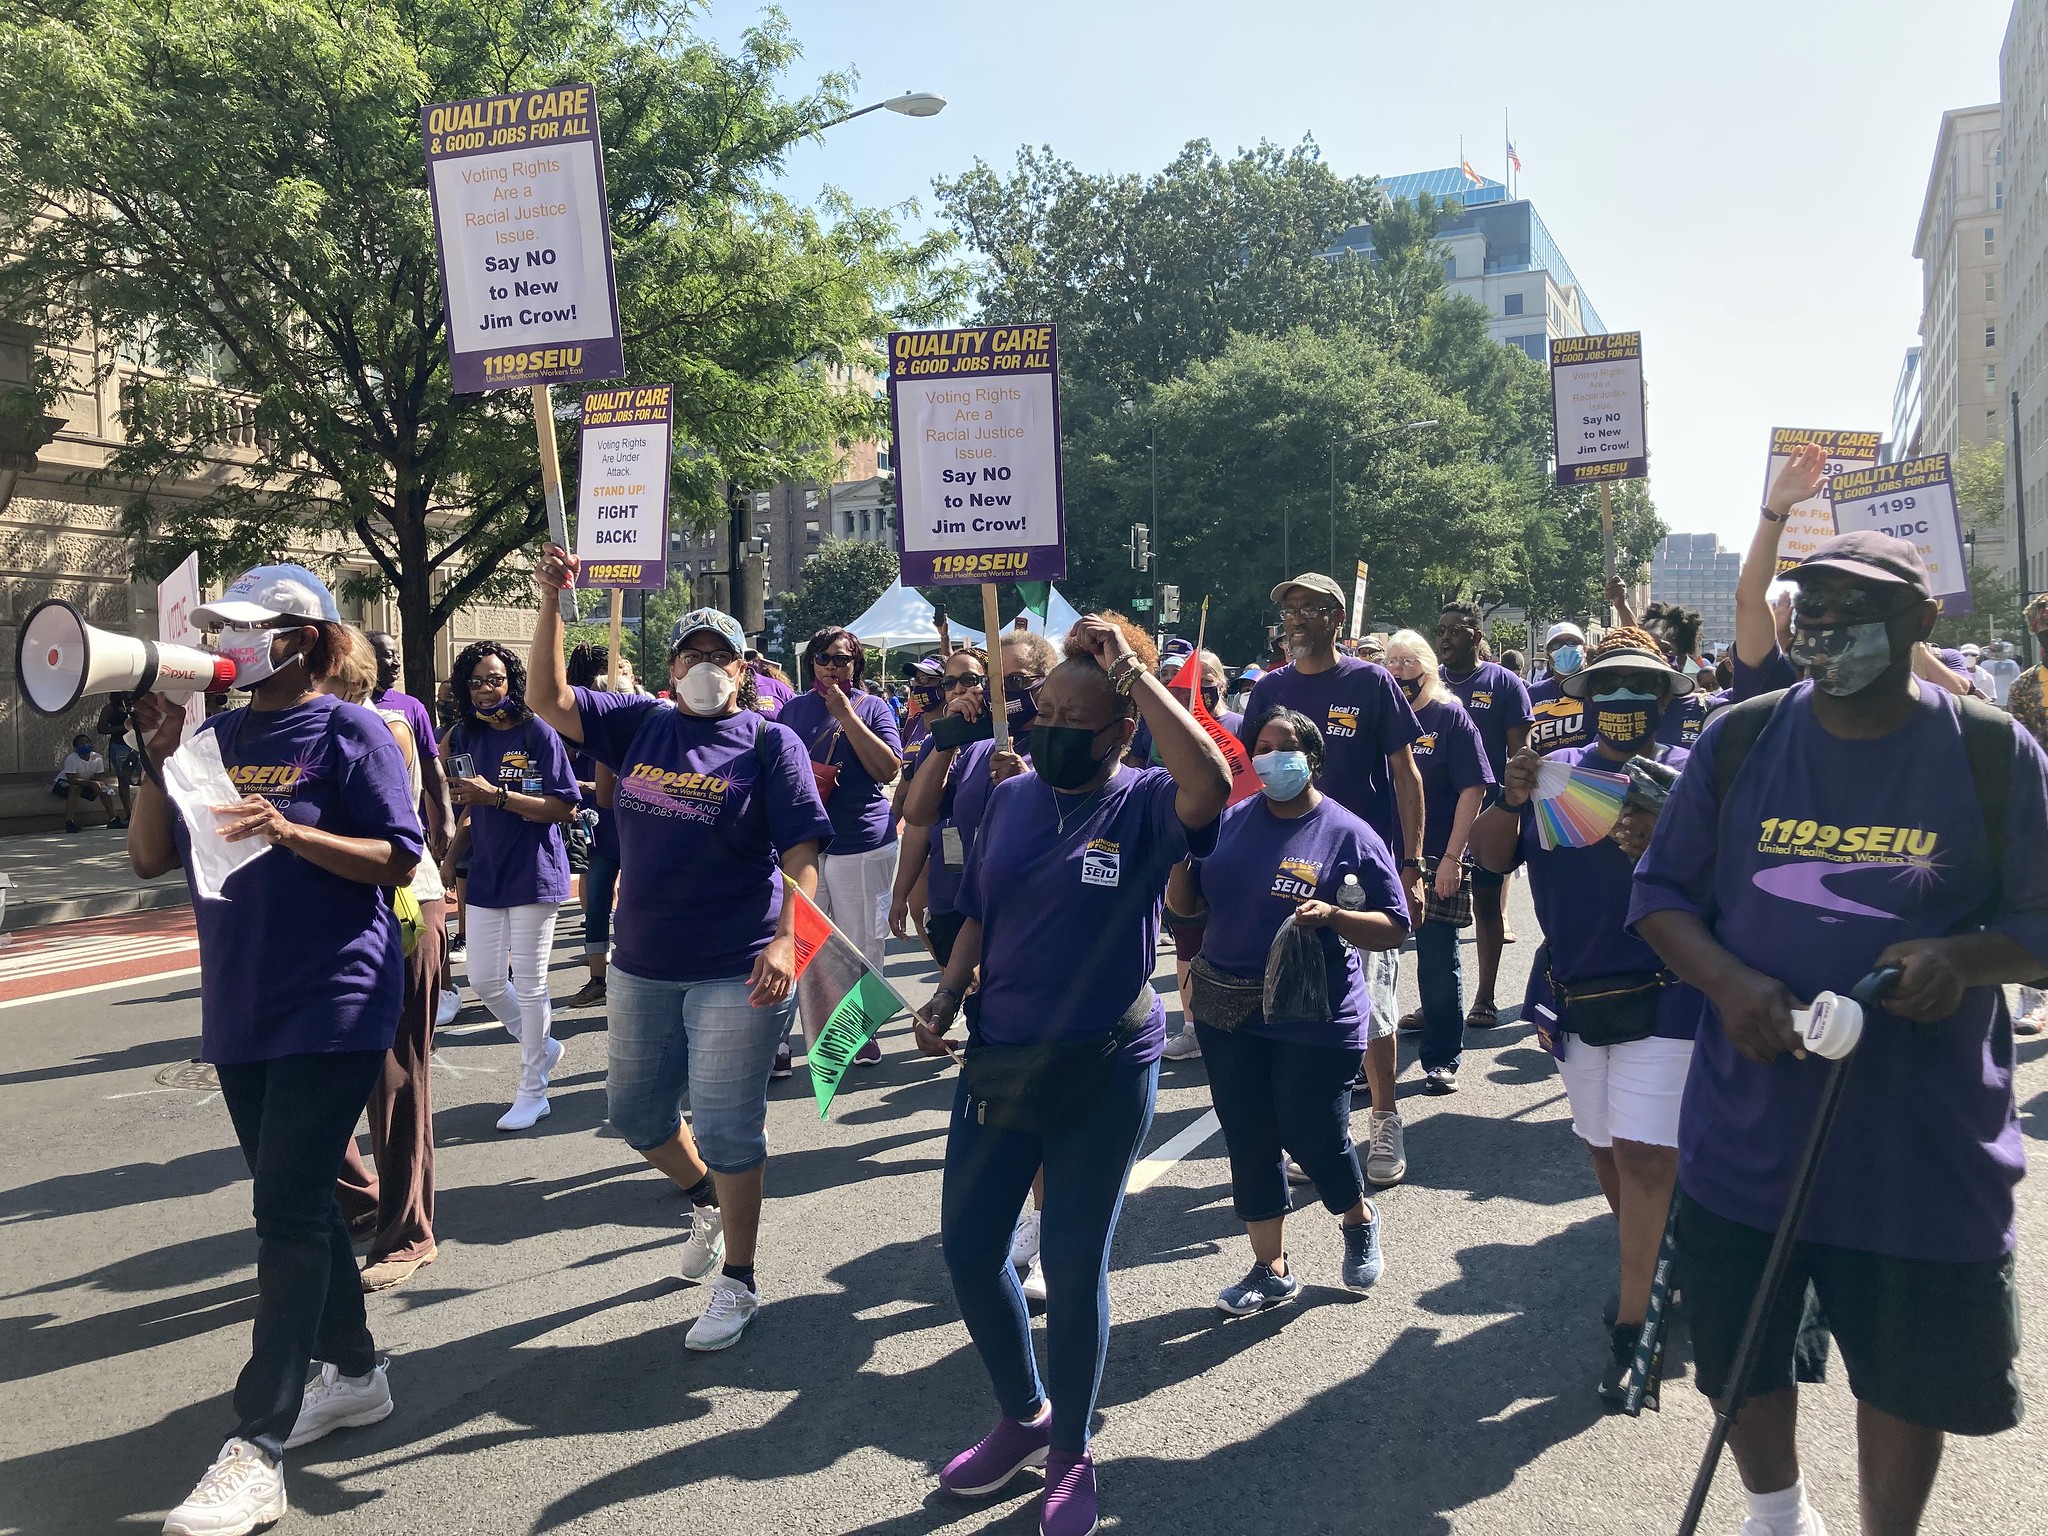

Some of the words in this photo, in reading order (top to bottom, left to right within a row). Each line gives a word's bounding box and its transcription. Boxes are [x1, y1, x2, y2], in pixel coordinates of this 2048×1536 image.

[429, 98, 522, 135] QUALITY
[528, 88, 588, 121] CARE
[431, 141, 442, 155] &
[446, 132, 485, 152] GOOD
[488, 127, 526, 146] JOBS
[529, 122, 559, 141] FOR
[562, 119, 590, 135] ALL
[461, 164, 508, 185] Voting
[512, 158, 560, 179] Rights
[493, 187, 518, 202] Are
[523, 186, 532, 198] a
[465, 209, 510, 228] Racial
[514, 202, 567, 221] Justice
[495, 229, 540, 245] Issue.
[485, 255, 520, 275] Say
[526, 249, 557, 267] NO
[489, 285, 508, 301] to
[514, 279, 559, 298] New
[479, 313, 513, 331] Jim
[519, 304, 578, 326] Crow!
[895, 331, 988, 359] QUALITY
[992, 328, 1051, 353] CARE
[1553, 336, 1603, 355] QUALITY
[1606, 333, 1639, 349] CARE
[483, 347, 582, 376] 1199SEIU
[895, 361, 907, 375] &
[911, 358, 949, 375] GOOD
[952, 356, 990, 373] JOBS
[993, 354, 1021, 370] FOR
[1024, 353, 1050, 369] ALL
[1553, 354, 1560, 364] &
[1562, 353, 1584, 363] GOOD
[1585, 350, 1606, 361] JOBS
[1607, 348, 1623, 359] FOR
[1624, 347, 1639, 357] ALL
[486, 374, 506, 383] United
[506, 370, 539, 381] Healthcare
[540, 367, 569, 378] Workers
[570, 366, 584, 375] East
[1572, 370, 1598, 381] Voting
[584, 390, 635, 413] QUALITY
[635, 387, 670, 408] CARE
[926, 390, 971, 405] Voting
[976, 387, 1021, 404] Rights
[584, 414, 590, 425] &
[591, 411, 612, 424] GOOD
[612, 409, 634, 422] JOBS
[634, 408, 651, 421] FOR
[651, 407, 668, 419] ALL
[955, 410, 980, 422] Are
[985, 411, 993, 420] a
[1582, 415, 1602, 426] Say
[1605, 412, 1621, 422] NO
[926, 428, 970, 443] Racial
[974, 426, 1024, 440] Justice
[1584, 431, 1595, 440] to
[1598, 428, 1622, 438] New
[1774, 428, 1836, 446] QUALITY
[1837, 432, 1880, 447] CARE
[597, 439, 621, 452] Voting
[621, 437, 647, 450] Rights
[1577, 445, 1597, 455] Jim
[1599, 440, 1630, 452] Crow!
[1772, 443, 1780, 452] &
[1836, 447, 1856, 456] FOR
[1857, 448, 1876, 458] ALL
[602, 453, 615, 464] Are
[616, 451, 640, 463] Under
[955, 447, 997, 460] Issue.
[606, 466, 632, 478] Attack.
[942, 468, 977, 486] Say
[983, 466, 1012, 482] NO
[1574, 462, 1628, 477] 1199SEIU
[1832, 464, 1899, 491] QUALITY
[1902, 455, 1946, 477] CARE
[593, 485, 625, 497] STAND
[628, 484, 645, 496] UP!
[1834, 491, 1842, 501] &
[1844, 485, 1873, 499] GOOD
[1874, 480, 1902, 494] JOBS
[1904, 475, 1925, 488] FOR
[1927, 471, 1947, 483] ALL
[944, 494, 963, 508] to
[969, 493, 1012, 507] New
[1867, 496, 1917, 517] 1199
[597, 505, 638, 520] FIGHT
[932, 519, 966, 534] Jim
[972, 516, 1027, 533] Crow!
[596, 530, 637, 544] BACK!
[588, 564, 642, 578] 1199SEIU
[931, 553, 1029, 574] 1199SEIU
[933, 571, 953, 580] United
[954, 570, 988, 580] Healthcare
[989, 569, 1014, 578] Workers
[1015, 568, 1029, 576] East
[680, 610, 735, 636] LOVE
[1329, 704, 1350, 715] Local
[1351, 706, 1360, 716] 73
[1470, 702, 1491, 710] SEIU
[1598, 711, 1633, 723] RESPECT
[1634, 711, 1648, 721] US.
[1326, 726, 1356, 738] SEIU
[1531, 714, 1584, 744] SEIU
[1598, 720, 1633, 733] PROTECT
[1559, 733, 1588, 745] Together
[1617, 733, 1634, 741] US.
[1412, 747, 1434, 755] SEIU
[629, 763, 731, 793] 1199SEIU
[243, 784, 274, 792] Workers
[276, 785, 293, 793] East
[626, 778, 646, 787] United
[646, 781, 678, 794] Healthcare
[680, 788, 707, 798] Workers
[708, 792, 724, 802] East
[620, 789, 663, 805] QUALITY
[664, 797, 694, 810] CARE
[695, 804, 721, 815] AND
[619, 799, 647, 813] GOOD
[648, 806, 673, 818] JOBS
[674, 811, 696, 821] FOR
[697, 815, 716, 826] ALL
[1760, 817, 1938, 856] 1199SEIU
[1283, 856, 1310, 865] LOCAL
[1311, 860, 1324, 868] 73
[1757, 842, 1790, 855] United
[1793, 844, 1853, 863] Healthcare
[1856, 853, 1905, 864] Workers
[1908, 856, 1932, 869] East
[1084, 867, 1118, 879] SEIU
[1271, 879, 1317, 898] SEIU
[1640, 1321, 1656, 1348] EAGLES
